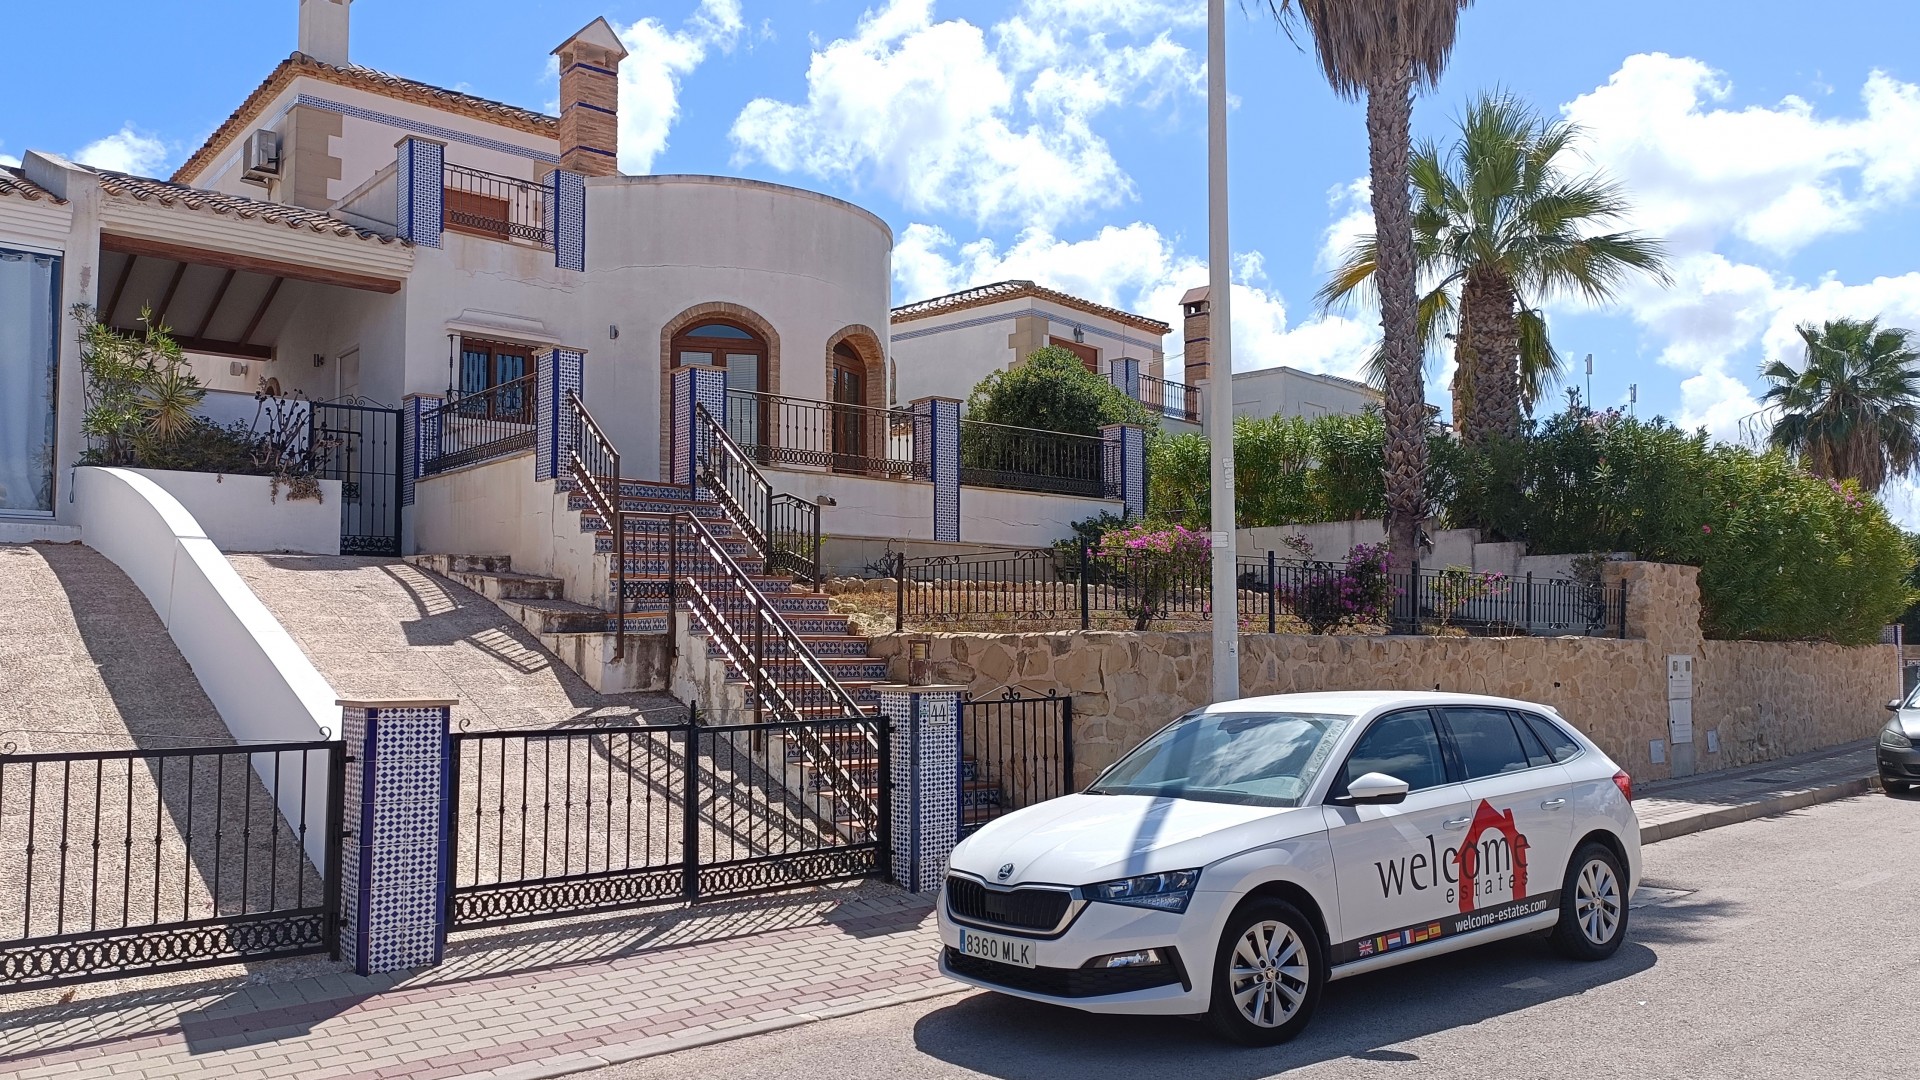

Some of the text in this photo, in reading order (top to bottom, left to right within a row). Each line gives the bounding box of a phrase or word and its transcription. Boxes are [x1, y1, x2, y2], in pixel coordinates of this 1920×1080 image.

[930, 703, 947, 722] 44
[1375, 834, 1528, 898] welcome
[1446, 872, 1528, 903] estates
[1455, 898, 1547, 933] welcome-estates.com
[966, 934, 1030, 965] 8360 MLK
